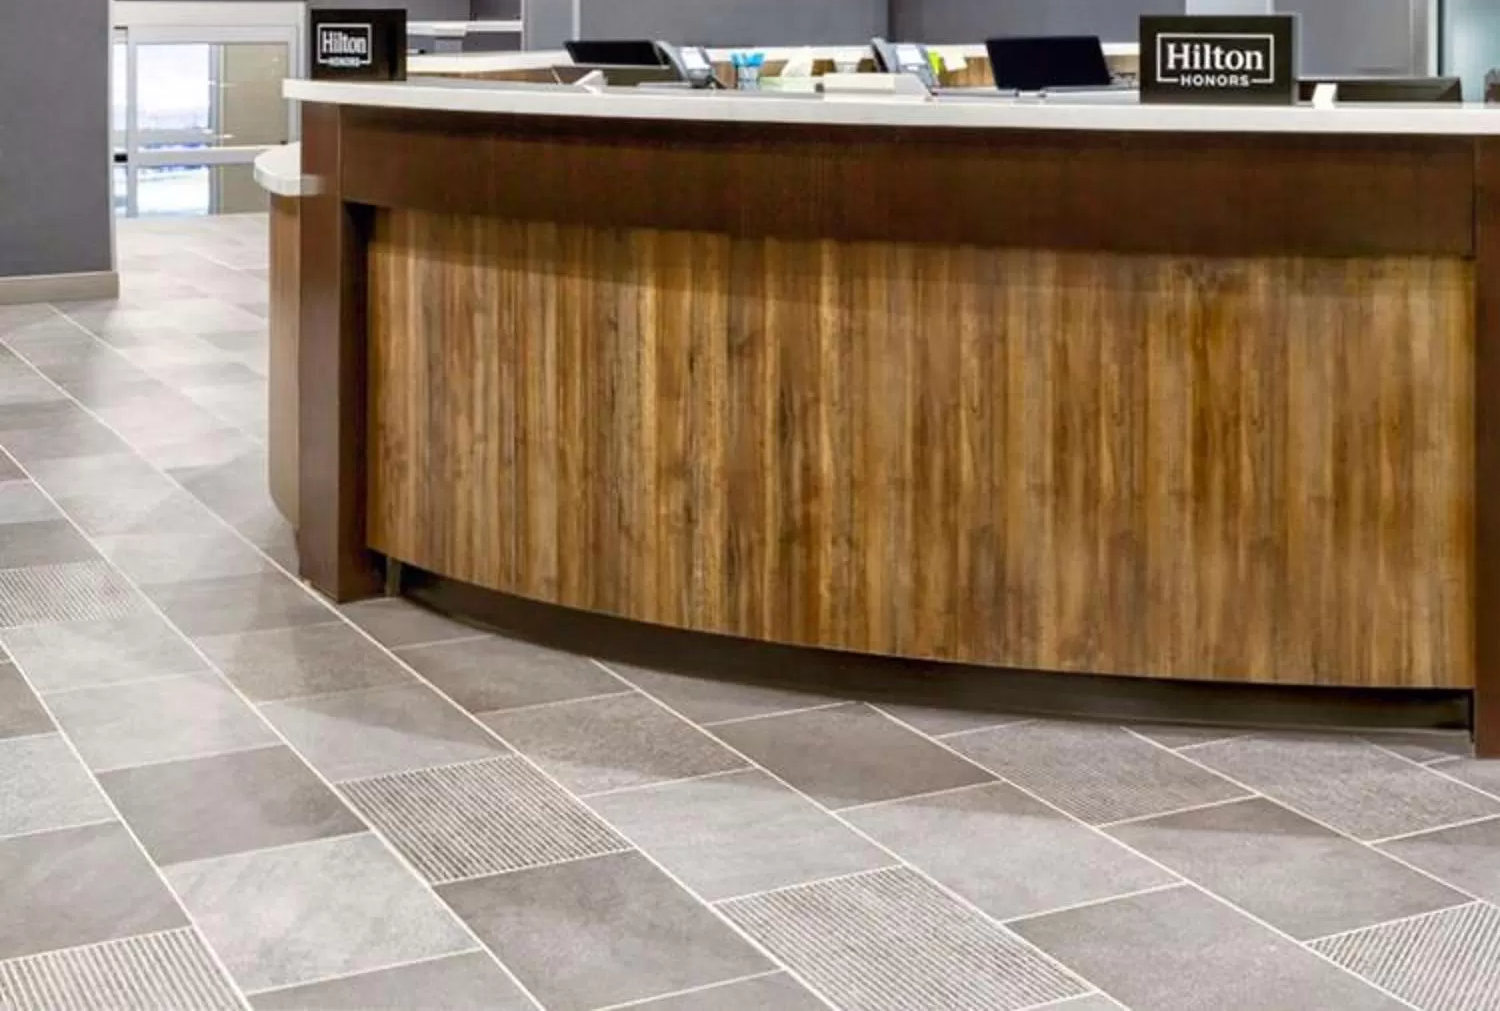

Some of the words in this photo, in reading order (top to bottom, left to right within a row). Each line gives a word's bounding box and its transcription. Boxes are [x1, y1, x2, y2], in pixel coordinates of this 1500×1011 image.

[322, 29, 368, 54] Hilton
[1166, 42, 1264, 70] Hilton
[1180, 74, 1250, 87] HONORS
